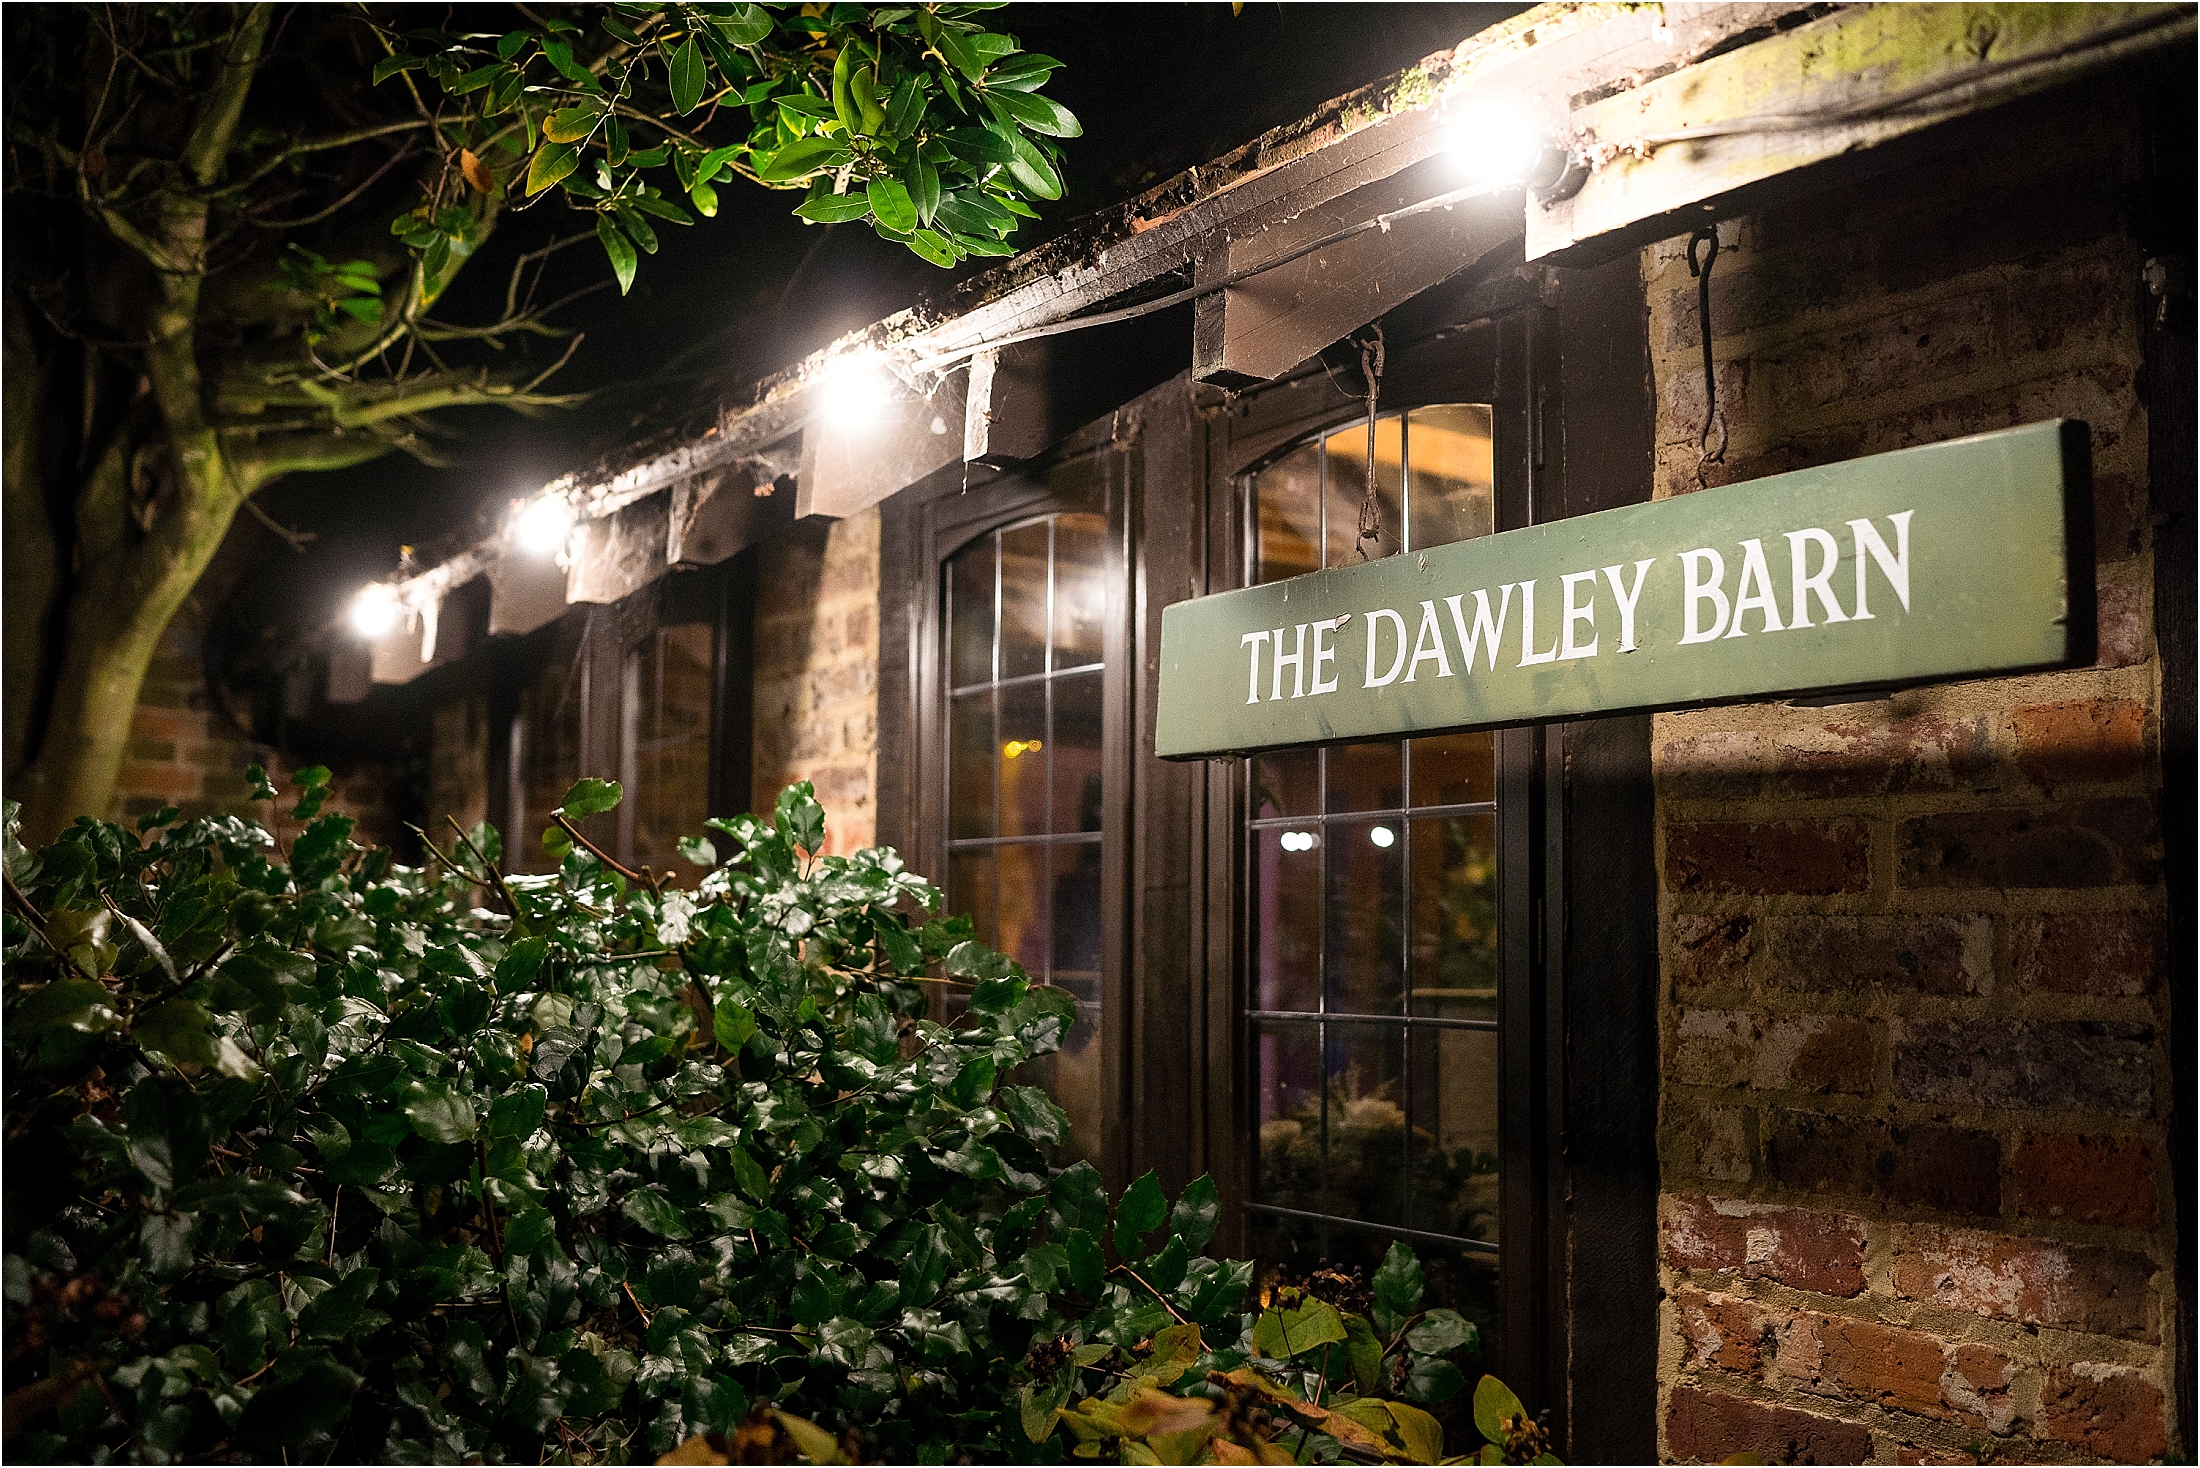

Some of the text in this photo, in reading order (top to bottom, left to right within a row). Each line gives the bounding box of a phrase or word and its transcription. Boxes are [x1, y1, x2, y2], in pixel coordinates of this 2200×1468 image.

[1240, 509, 1916, 705] THE DAWLEY BARN
